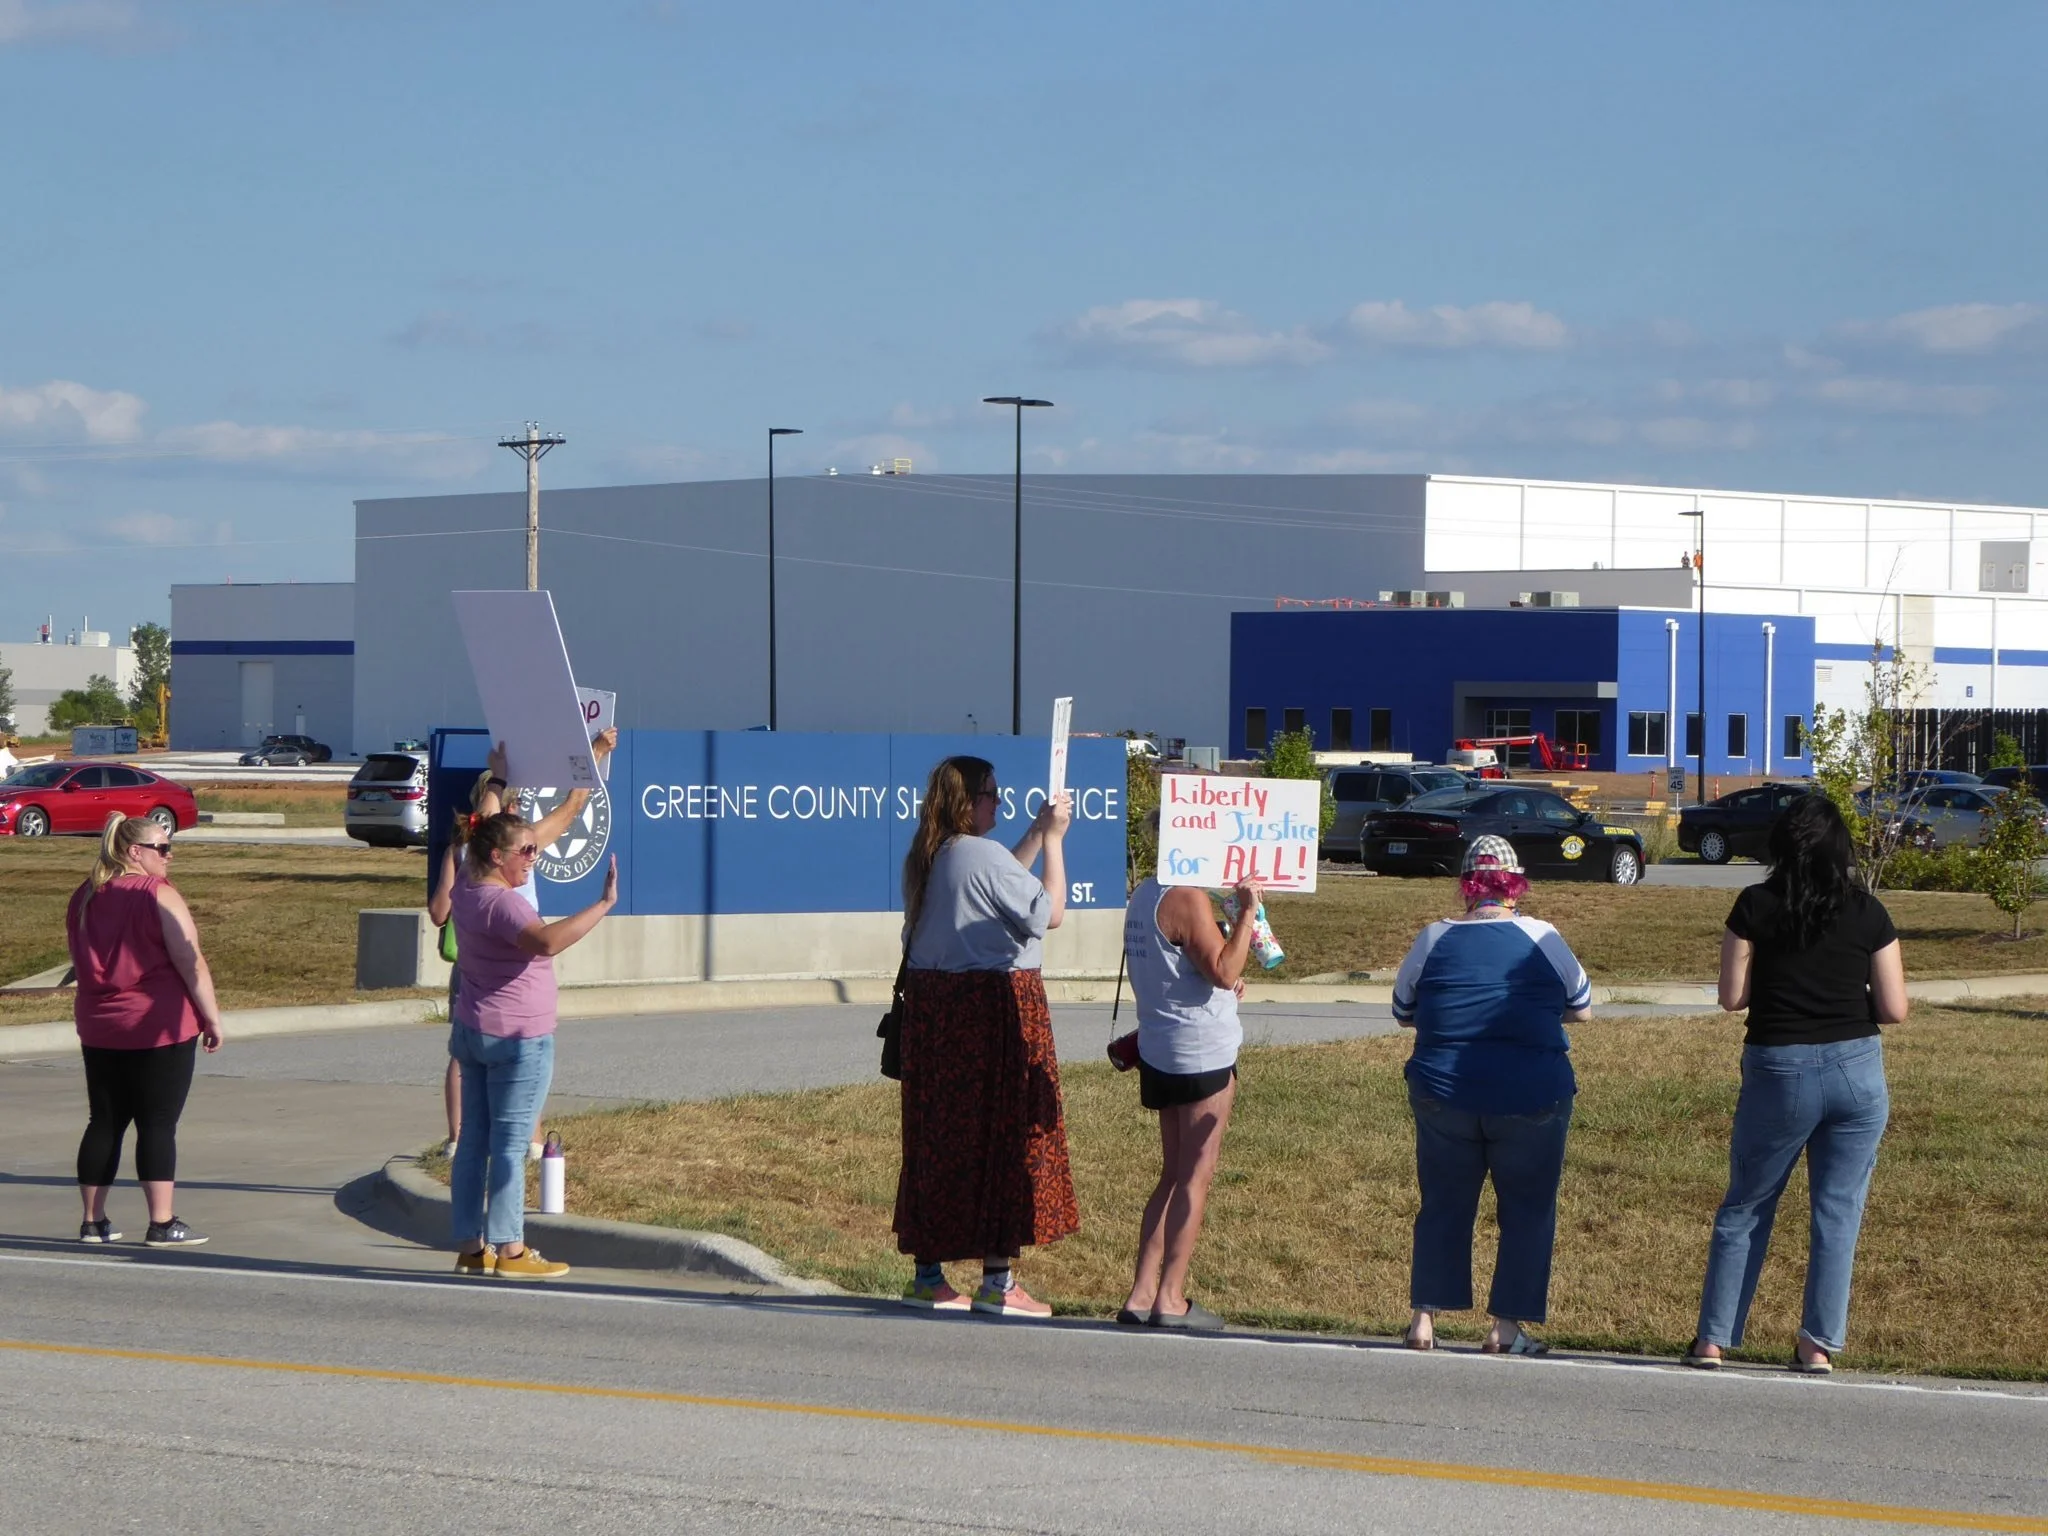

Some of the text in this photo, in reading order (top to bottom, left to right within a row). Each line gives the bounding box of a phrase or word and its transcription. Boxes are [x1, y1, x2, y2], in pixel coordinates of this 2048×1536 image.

[641, 784, 758, 819] GREENE
[768, 785, 887, 820] COUNTY
[1025, 787, 1119, 820] OICE
[1170, 777, 1269, 817] Liberty
[1670, 780, 1683, 790] 45
[1172, 810, 1318, 843] and Justice
[574, 825, 607, 874] OFFICE
[1164, 845, 1307, 882] for ALL!
[1071, 882, 1096, 903] ST.
